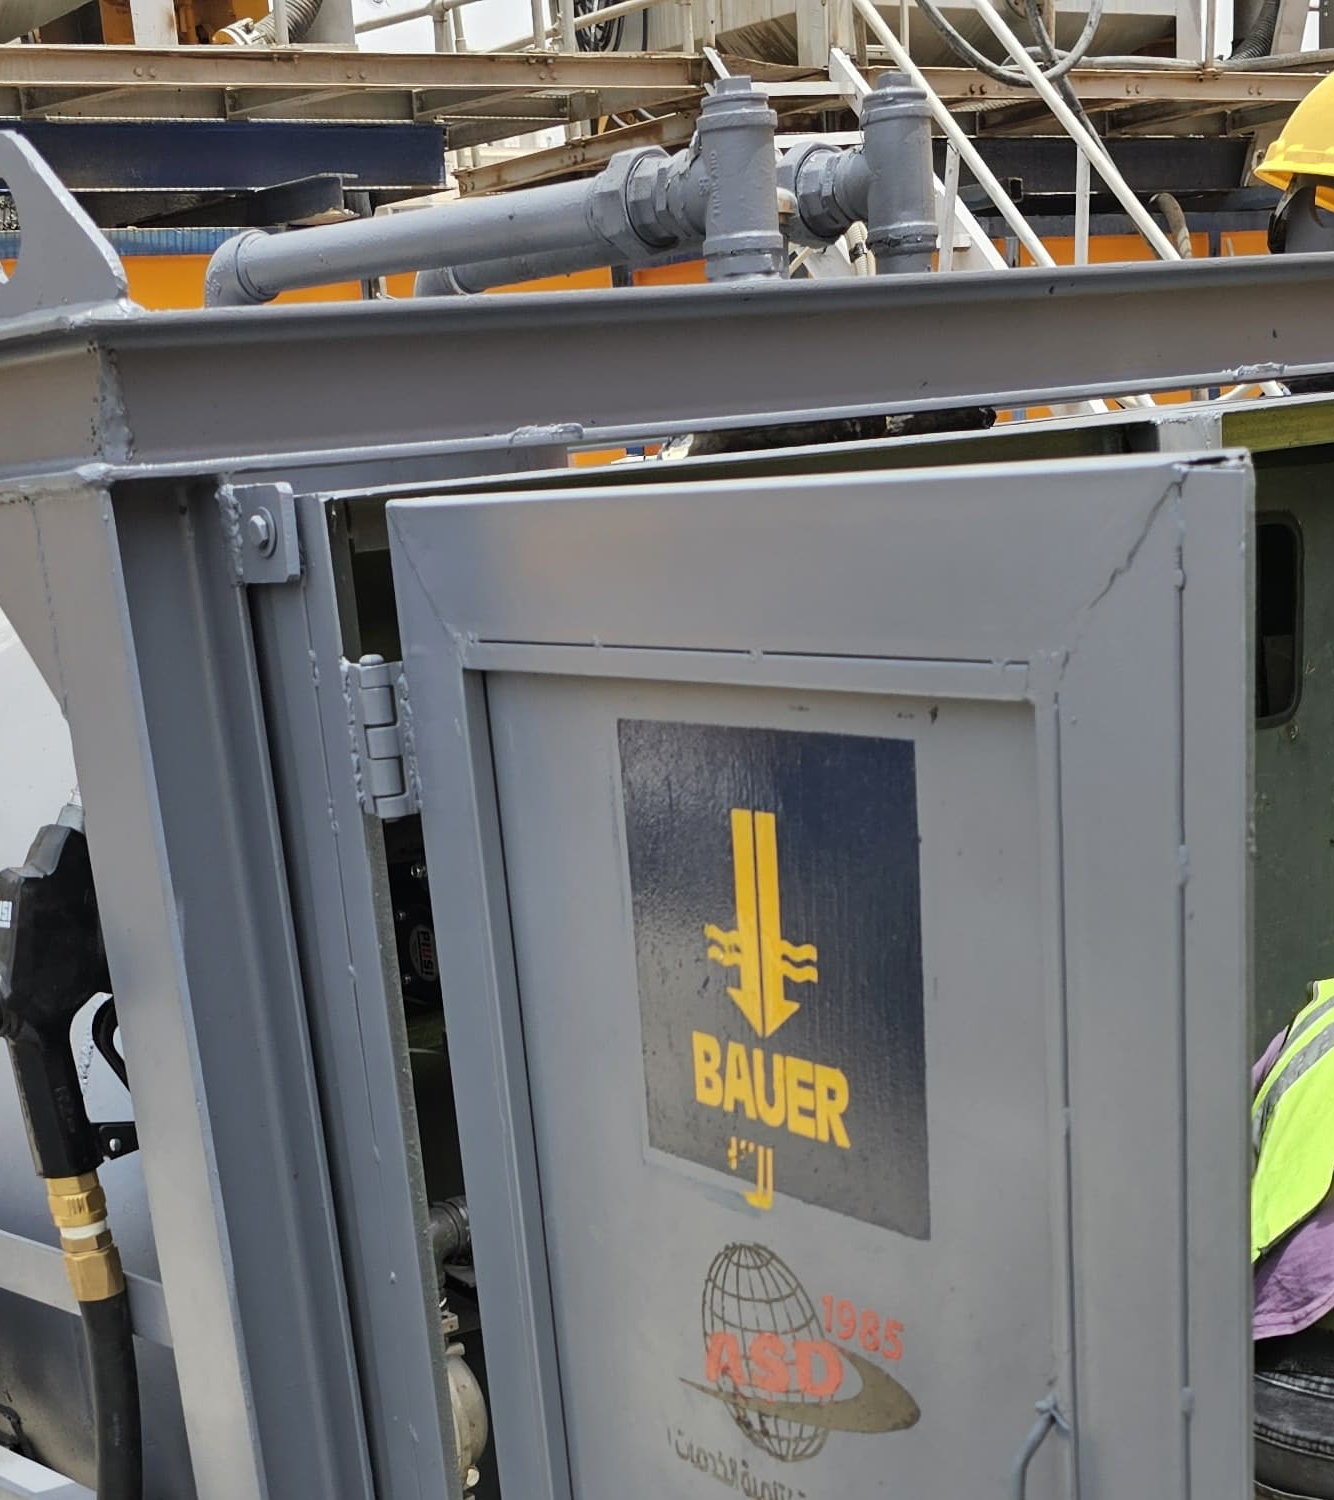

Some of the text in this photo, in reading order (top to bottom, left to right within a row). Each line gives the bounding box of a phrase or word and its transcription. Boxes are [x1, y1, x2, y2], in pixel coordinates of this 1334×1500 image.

[420, 930, 435, 976] PIUSI
[692, 1030, 851, 1149] BAUER
[821, 1295, 905, 1361] 1985
[705, 1332, 844, 1396] ASD
